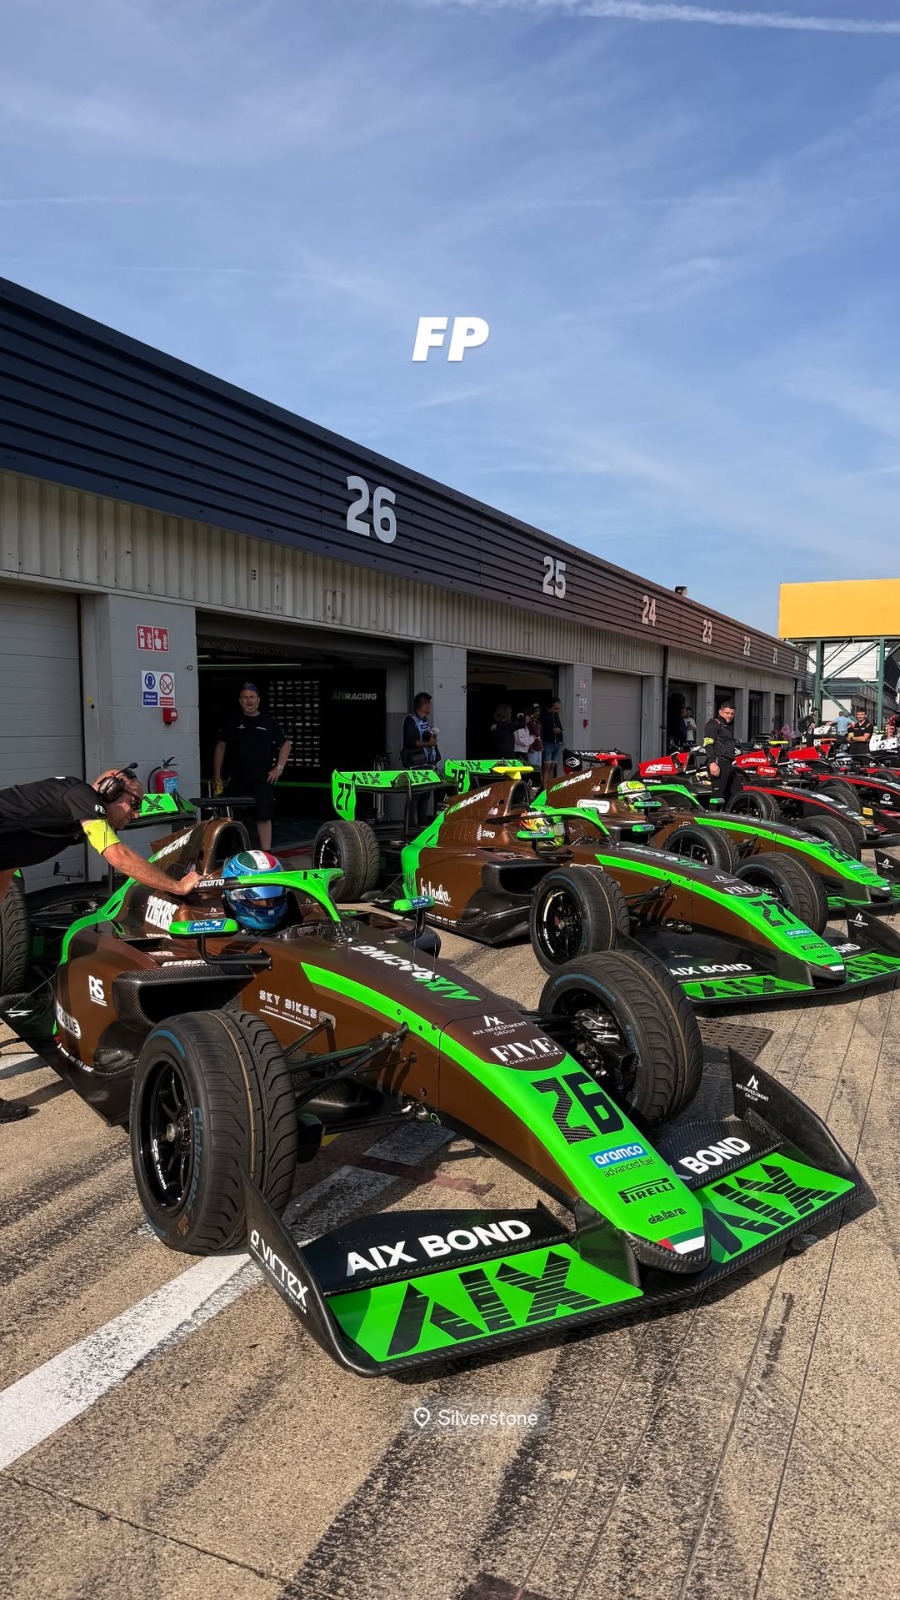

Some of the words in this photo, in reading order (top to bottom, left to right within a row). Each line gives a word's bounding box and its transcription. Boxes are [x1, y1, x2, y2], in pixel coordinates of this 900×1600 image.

[346, 475, 397, 544] 26
[542, 555, 567, 599] 25
[641, 594, 657, 627] 24
[702, 619, 713, 644] 23
[743, 635, 751, 656] 22
[337, 782, 351, 811] 27
[749, 900, 796, 927] 27
[669, 966, 701, 976] AIX
[699, 963, 752, 974] BOND
[88, 975, 105, 1000] RS
[259, 990, 280, 1006] SKY
[284, 998, 318, 1019] BIKES
[485, 1021, 528, 1033] INVESTMENT
[493, 1028, 516, 1036] GROUP
[490, 1037, 560, 1063] FIVE
[505, 1050, 563, 1066] COMMUNICATIONS
[530, 1071, 625, 1145] 26
[594, 1144, 643, 1165] aramco
[603, 1159, 640, 1177] advanced
[637, 1156, 655, 1168] fuel
[678, 1136, 751, 1174] BOND
[617, 1177, 676, 1205] PIRELLI
[648, 1207, 687, 1224] dallara
[346, 1240, 417, 1277] AIX
[418, 1220, 532, 1258] BOND
[386, 1251, 603, 1357] AIX
